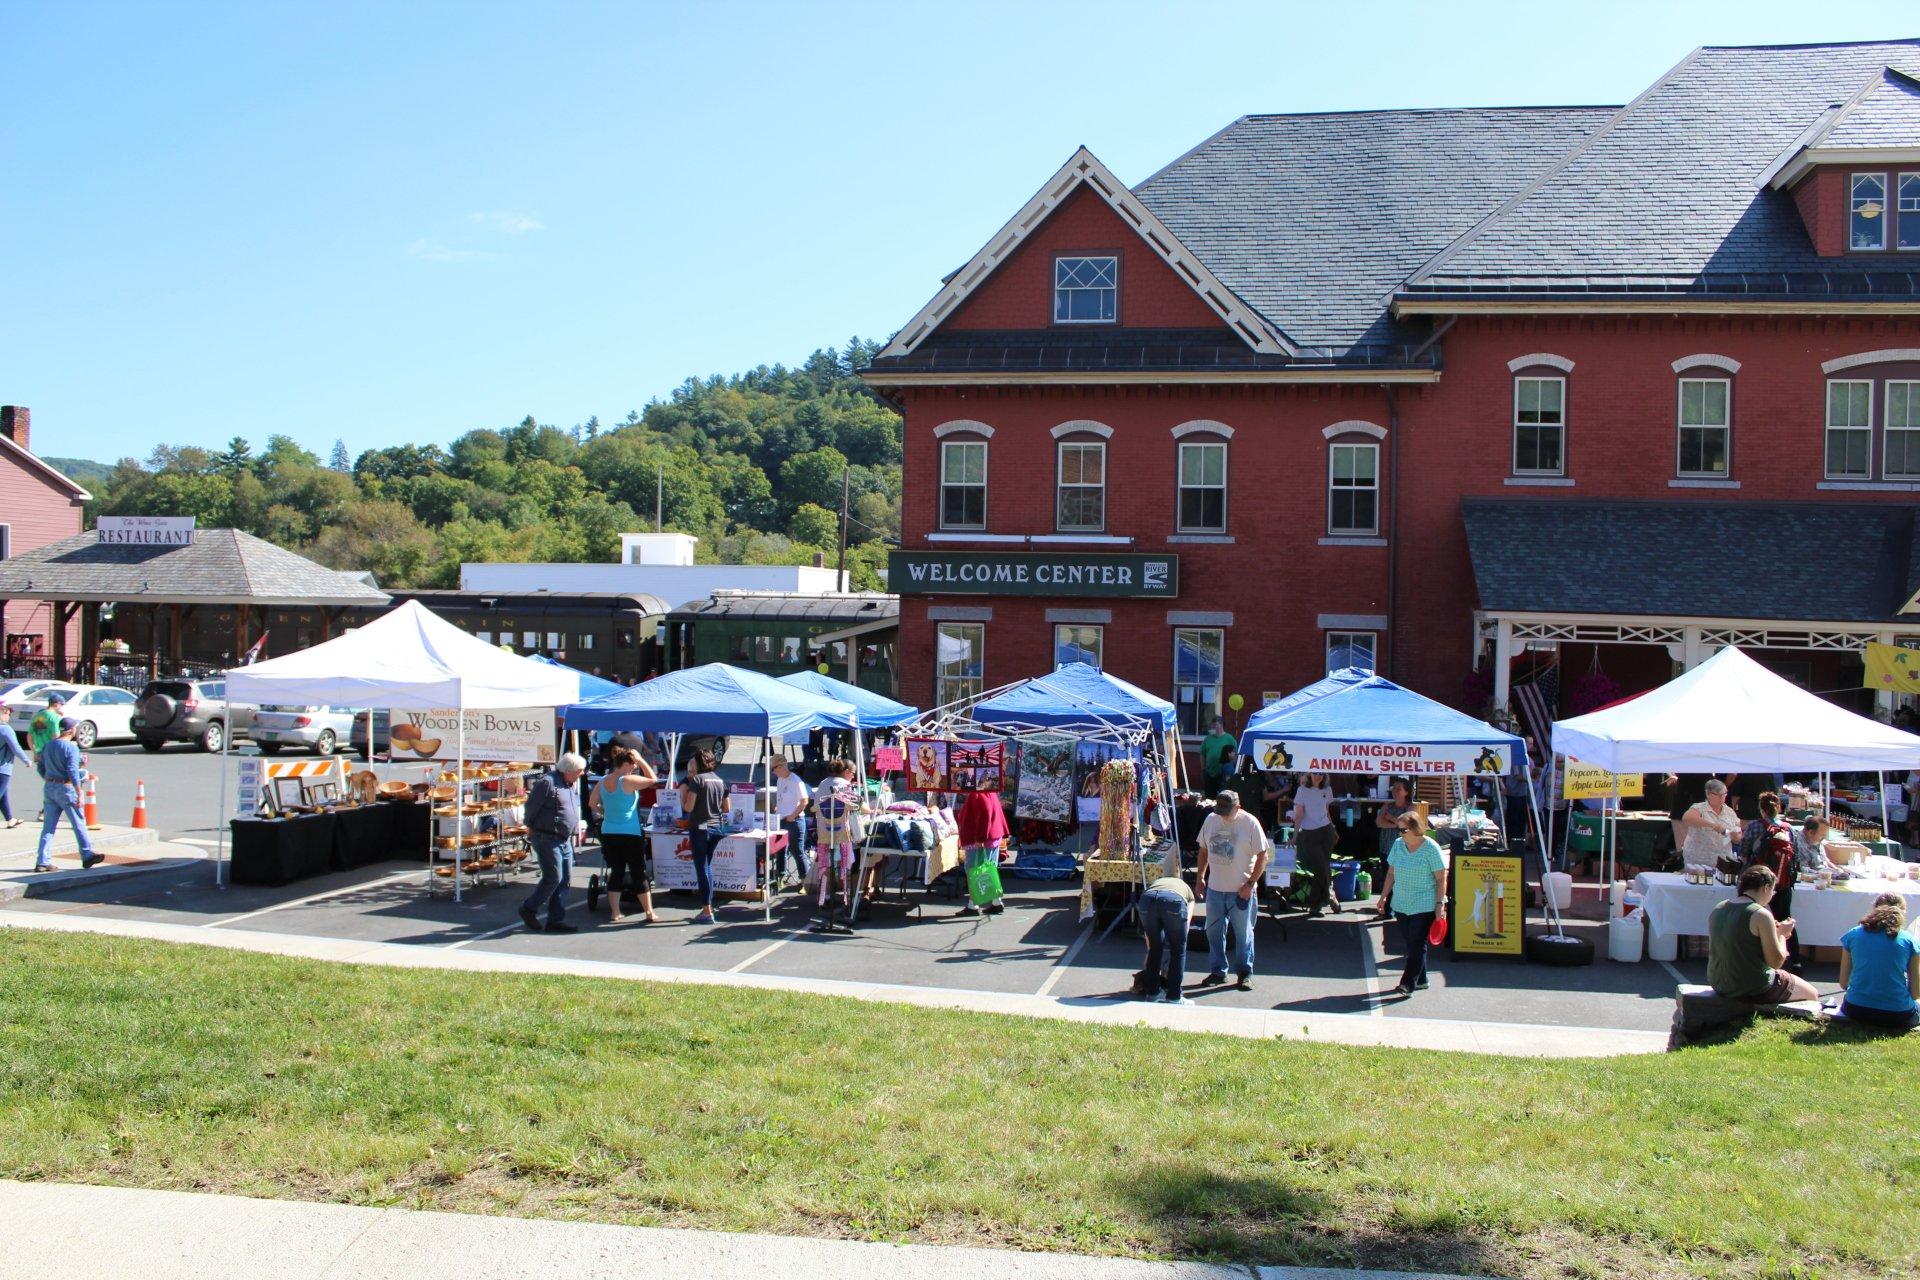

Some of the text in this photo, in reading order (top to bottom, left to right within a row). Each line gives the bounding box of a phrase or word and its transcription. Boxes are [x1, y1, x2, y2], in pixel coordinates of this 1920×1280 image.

[98, 529, 192, 544] RESTAURANT
[907, 563, 1133, 584] WELCOME CENTER
[430, 708, 480, 717] Sanderon's
[484, 714, 541, 732] BOWLS
[1341, 744, 1422, 758] KINGDOM
[1309, 758, 1456, 773] ANIMAL SHELTER
[1571, 780, 1593, 791] Apple
[1594, 780, 1612, 789] Cider
[1623, 779, 1636, 787] Tea
